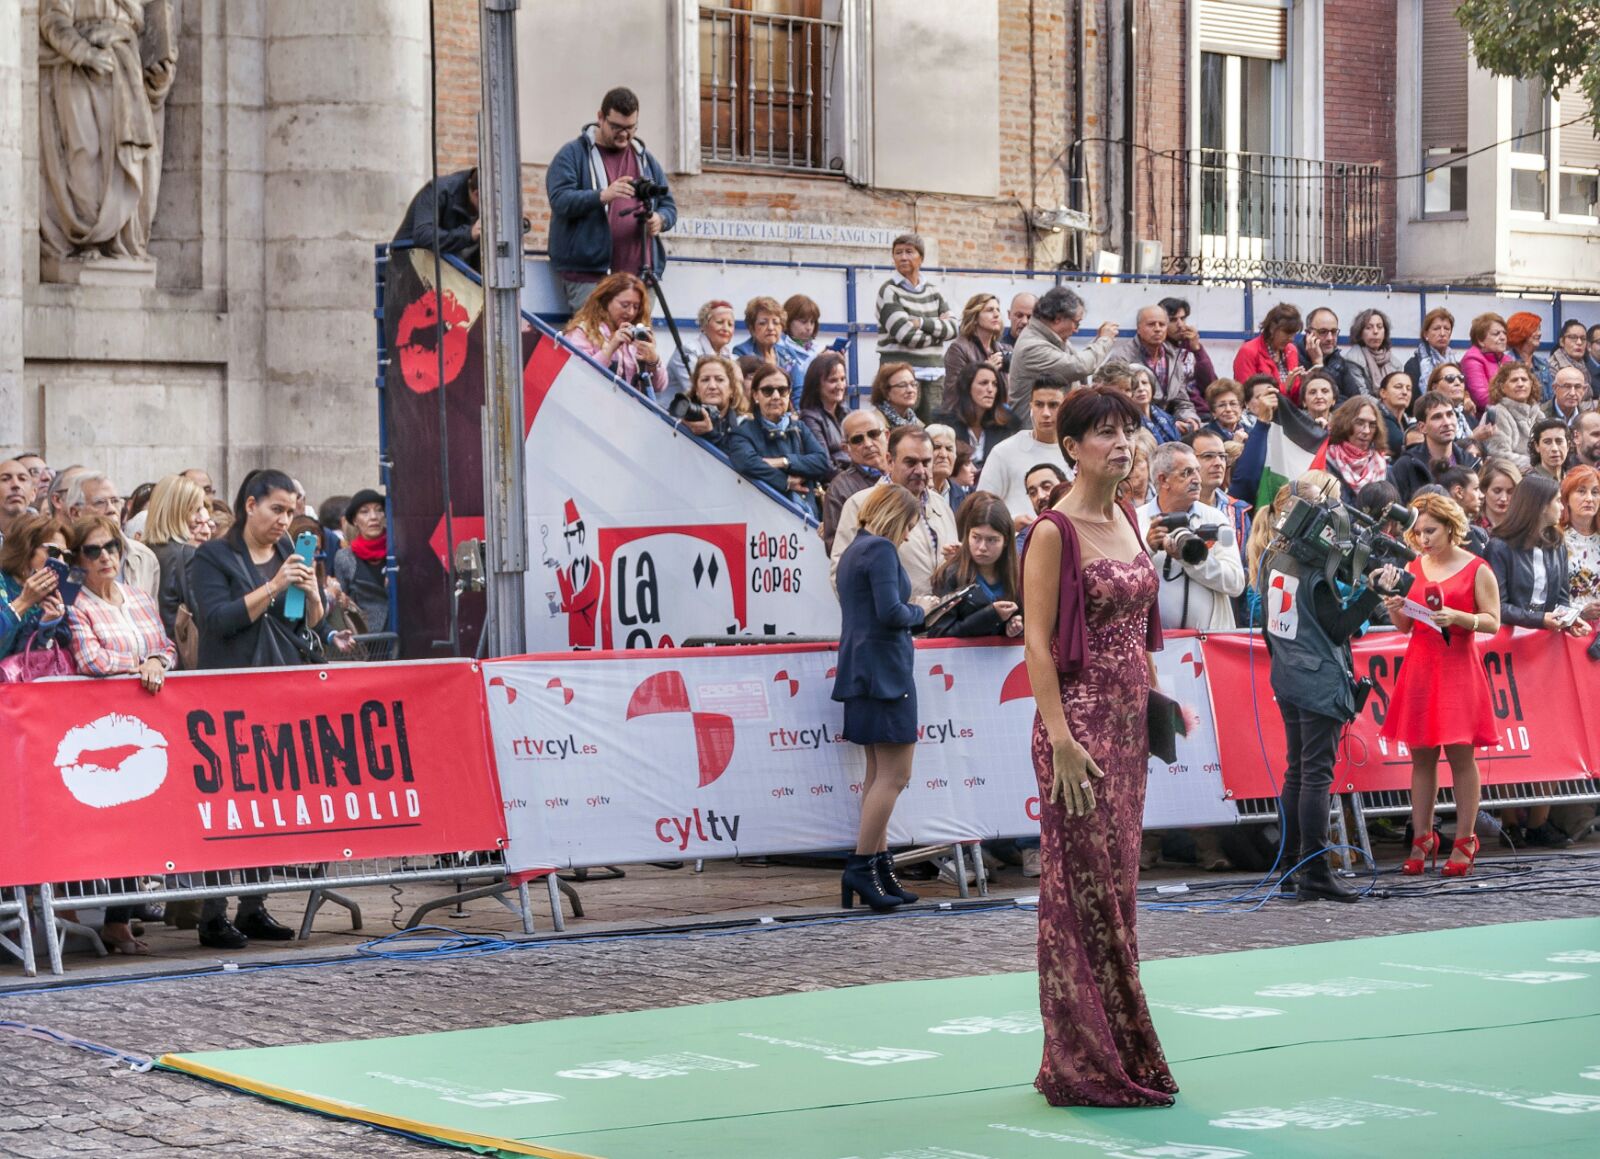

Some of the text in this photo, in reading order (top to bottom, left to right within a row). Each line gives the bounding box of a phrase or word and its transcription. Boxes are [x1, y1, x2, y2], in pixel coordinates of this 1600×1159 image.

[695, 221, 784, 239] PENITENCIAL
[789, 225, 804, 240] DE
[810, 226, 833, 241] LAS
[752, 566, 802, 594] copas
[186, 699, 415, 794] SEMINCI
[512, 734, 598, 760] rtvcyl.es
[1168, 764, 1189, 776] cyltv
[810, 783, 834, 796] cyltv
[926, 777, 948, 791] cyltv
[963, 776, 986, 789] cyltv
[771, 786, 794, 799] cyltv
[545, 796, 569, 809] cyltv
[586, 795, 611, 808] cyltv
[197, 788, 421, 831] VALLADOLID
[655, 807, 740, 852] cyltv
